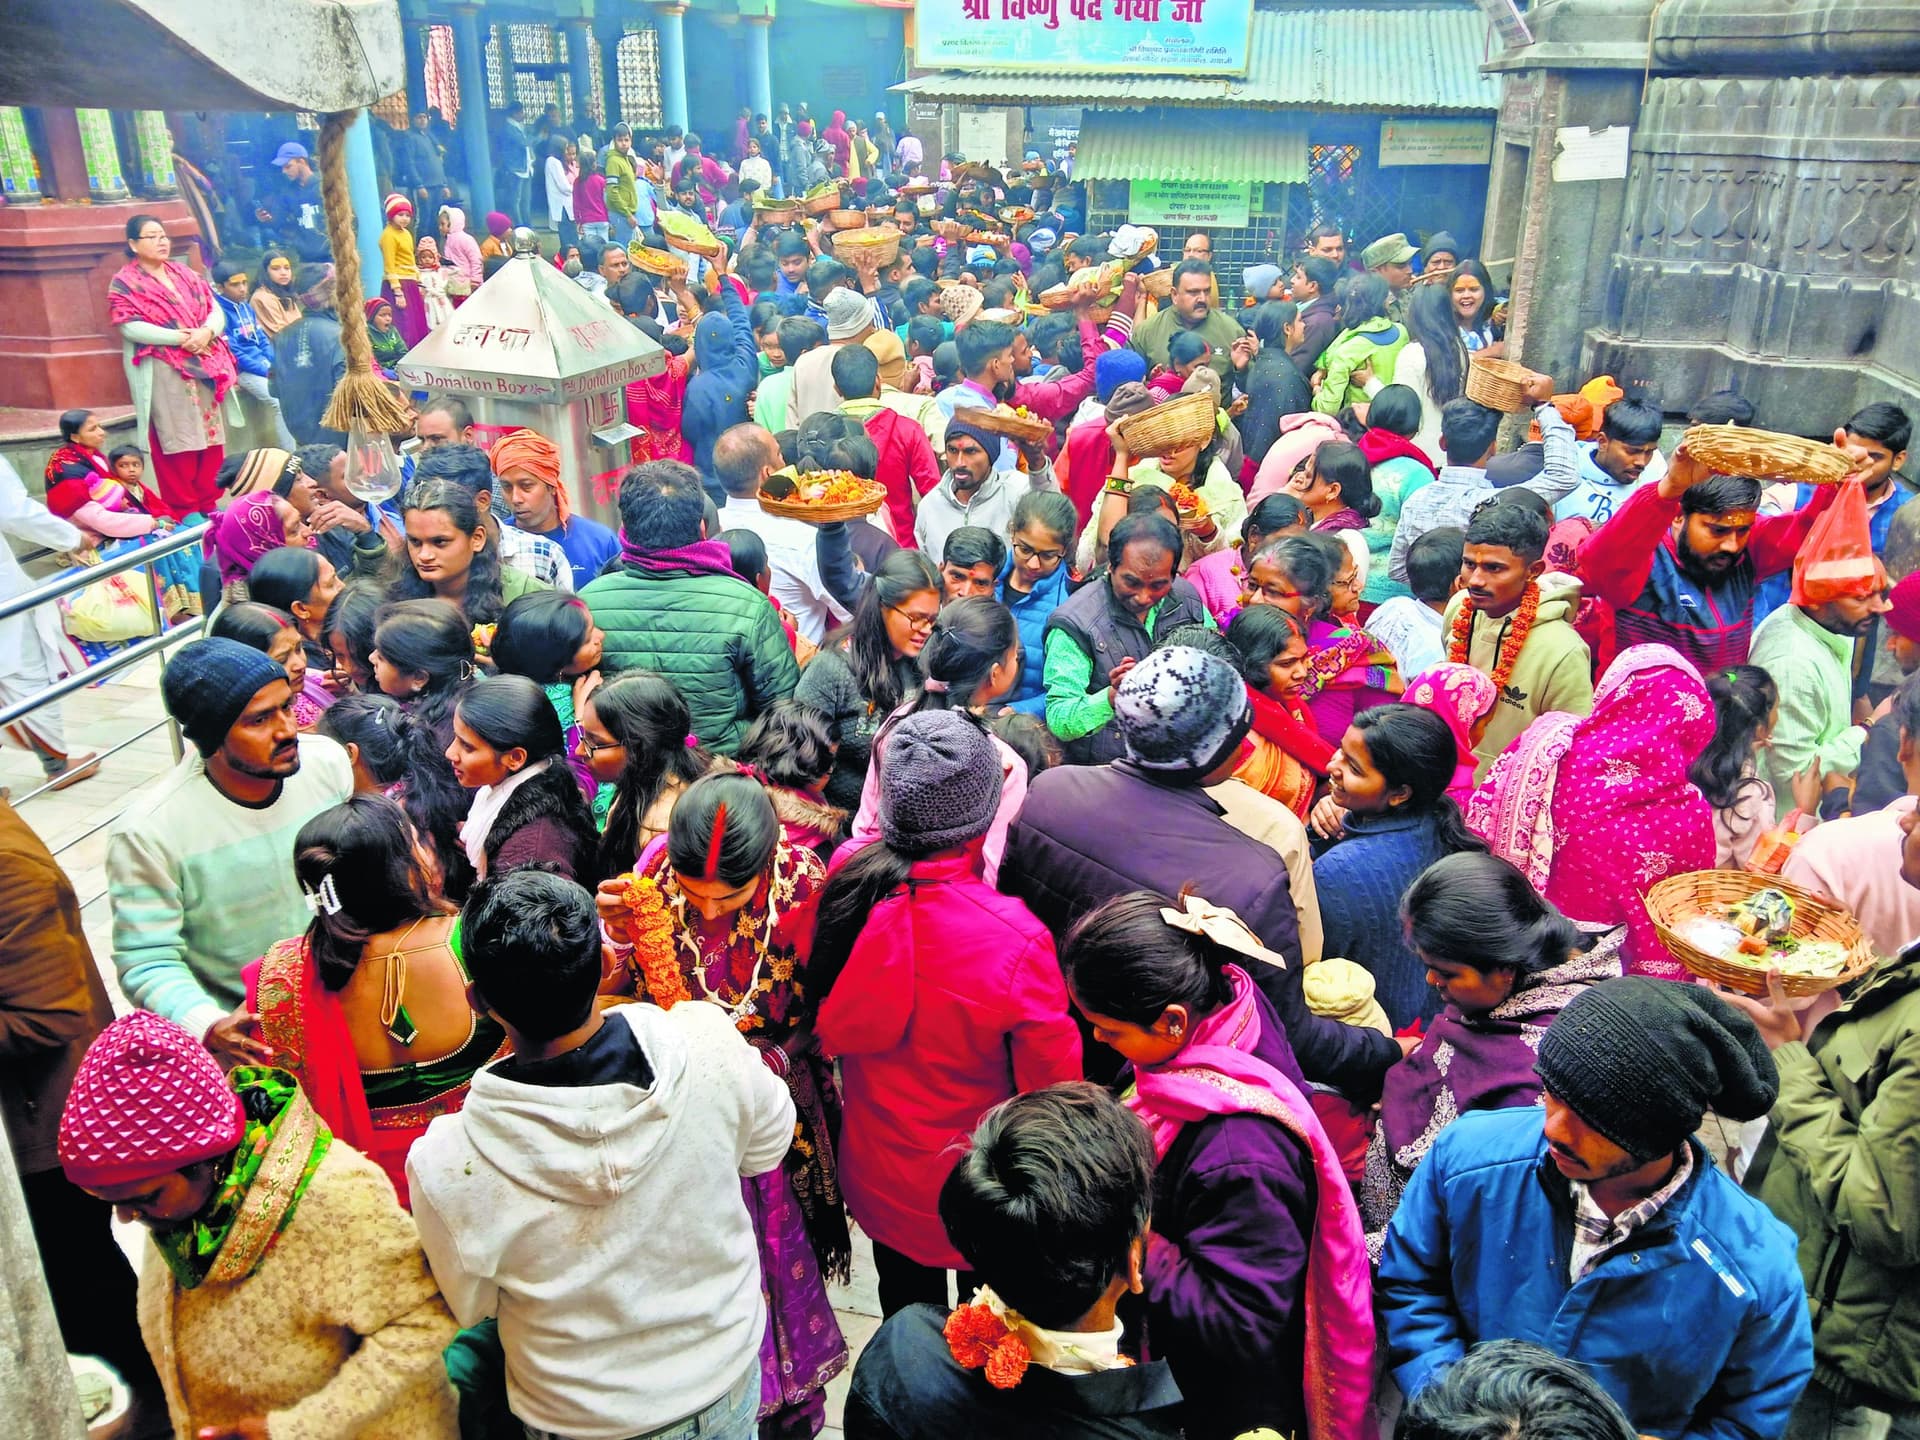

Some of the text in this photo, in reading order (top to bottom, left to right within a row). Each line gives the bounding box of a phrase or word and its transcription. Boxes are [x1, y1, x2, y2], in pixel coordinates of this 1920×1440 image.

[423, 371, 523, 395] Donation Box
[578, 360, 648, 393] Donation box
[1500, 696, 1525, 710] adidas
